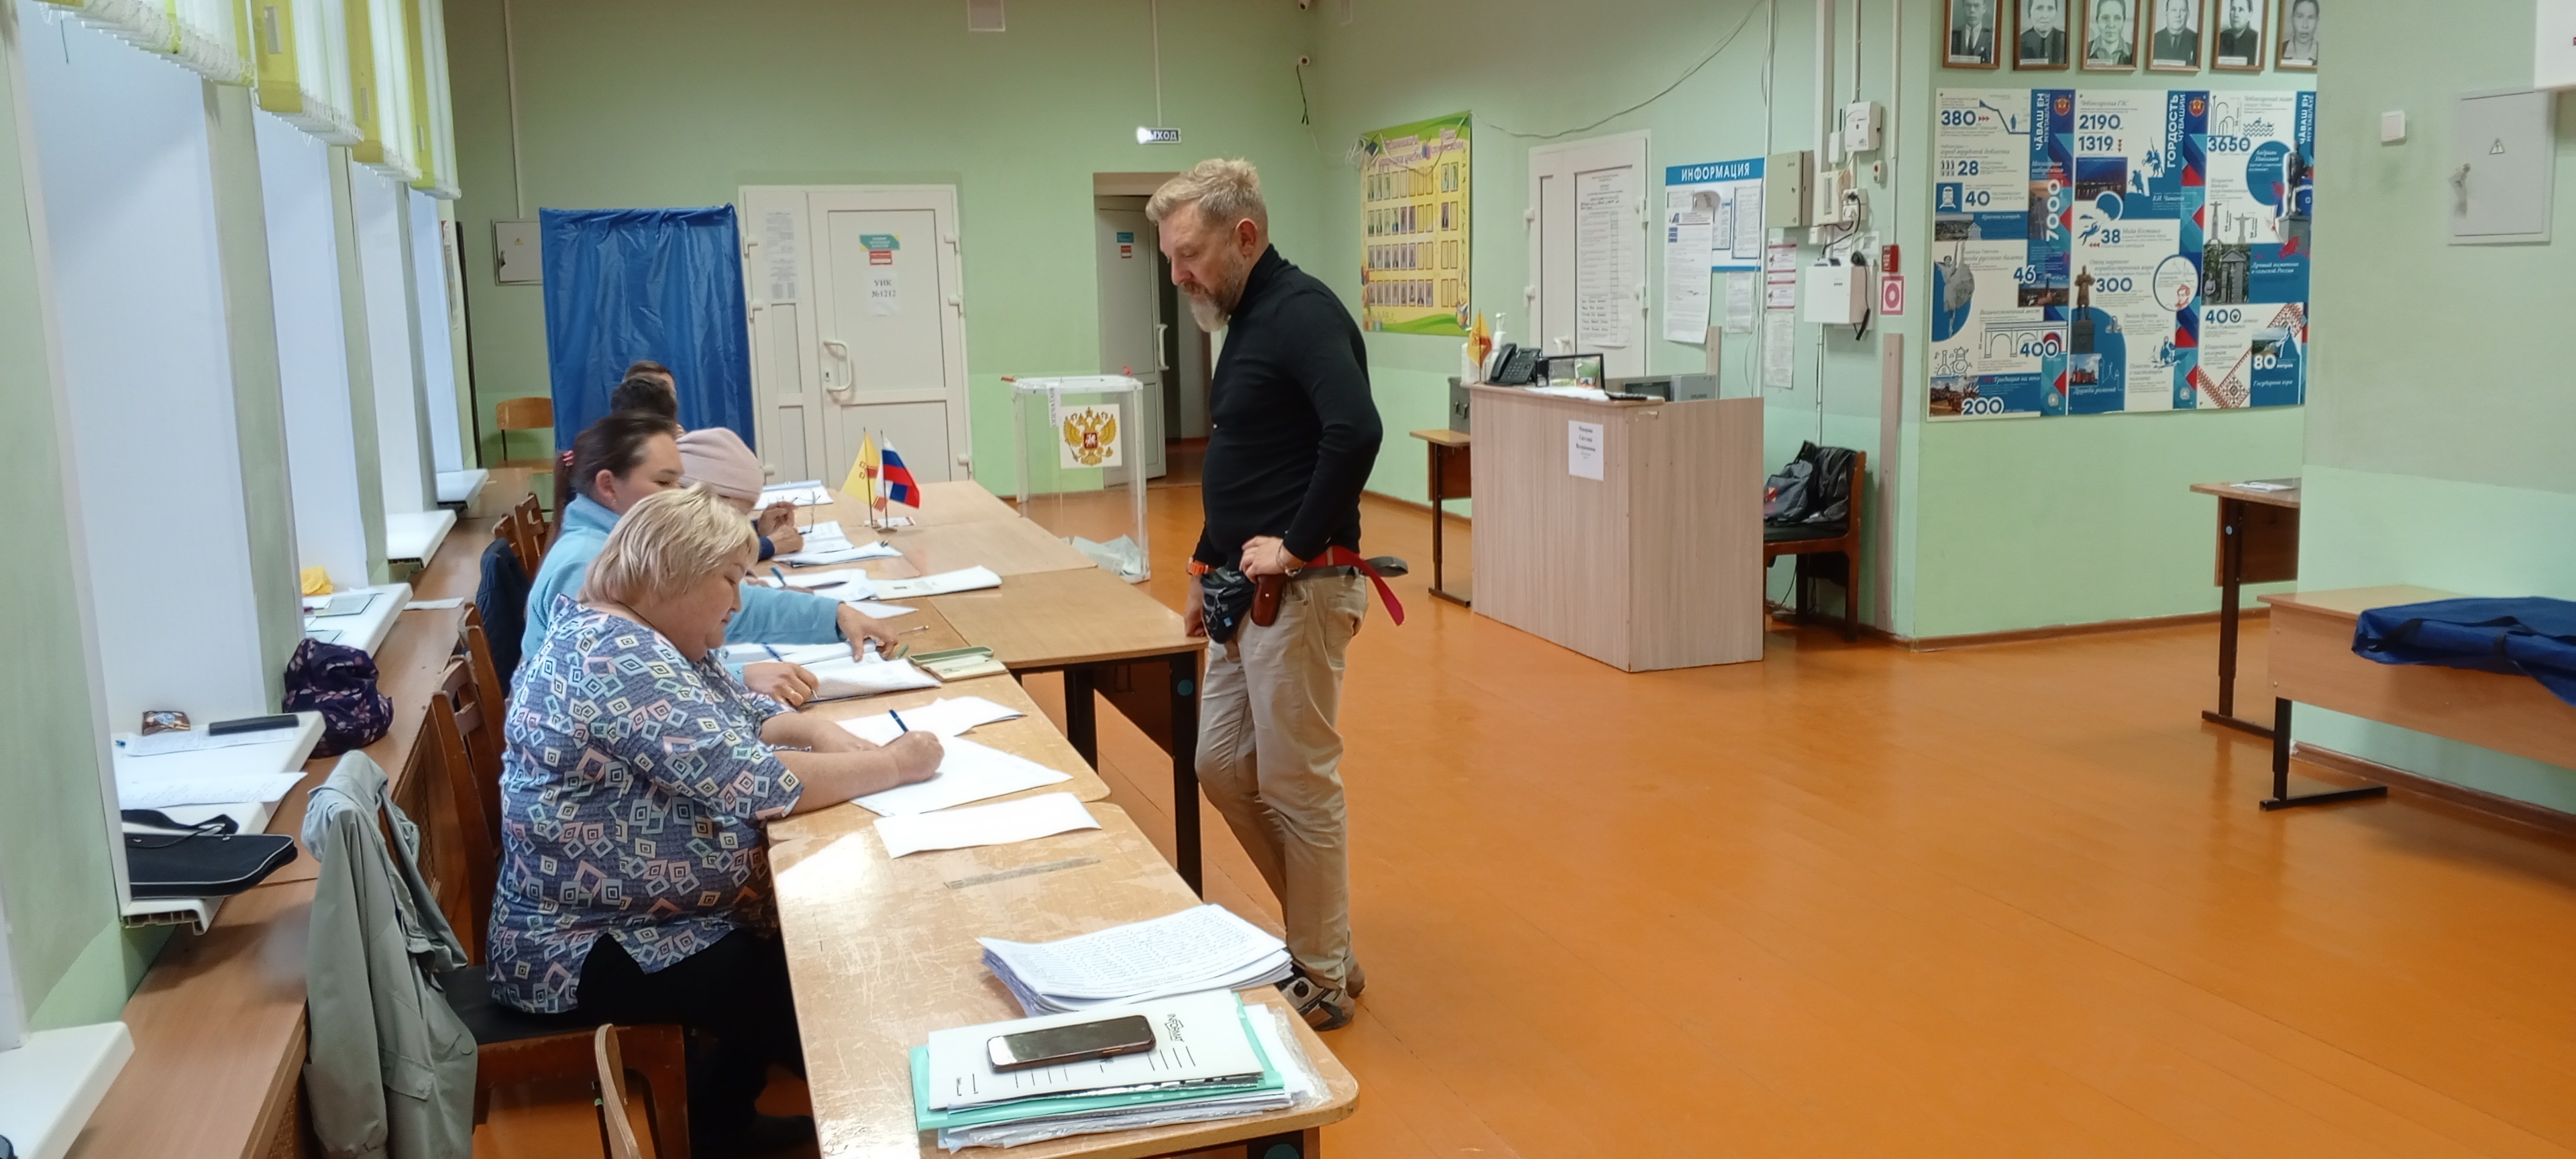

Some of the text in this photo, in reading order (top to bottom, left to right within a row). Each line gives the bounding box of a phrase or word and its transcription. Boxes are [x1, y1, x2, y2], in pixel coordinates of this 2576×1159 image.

[2037, 93, 2044, 107] ЕН
[1941, 109, 1976, 126] 380
[2079, 114, 2121, 130] 2190
[1144, 130, 1177, 141] ЫХОД
[2167, 94, 2179, 168] ГОРДОСТЬ
[2078, 135, 2113, 152] 1319
[2208, 137, 2251, 152] 3650
[1681, 162, 1750, 182] ИНФОРМАЦИЯ
[1957, 160, 1979, 176] 28
[1965, 190, 1990, 207] 40
[2046, 178, 2061, 241] 7000
[2101, 228, 2121, 244] 38
[2013, 264, 2036, 284] 46
[2096, 277, 2133, 292] 300
[871, 290, 897, 298] №1212
[2206, 309, 2241, 324] 400
[2020, 341, 2058, 358] 400
[2253, 354, 2277, 370] 80
[1962, 398, 2004, 415] 200
